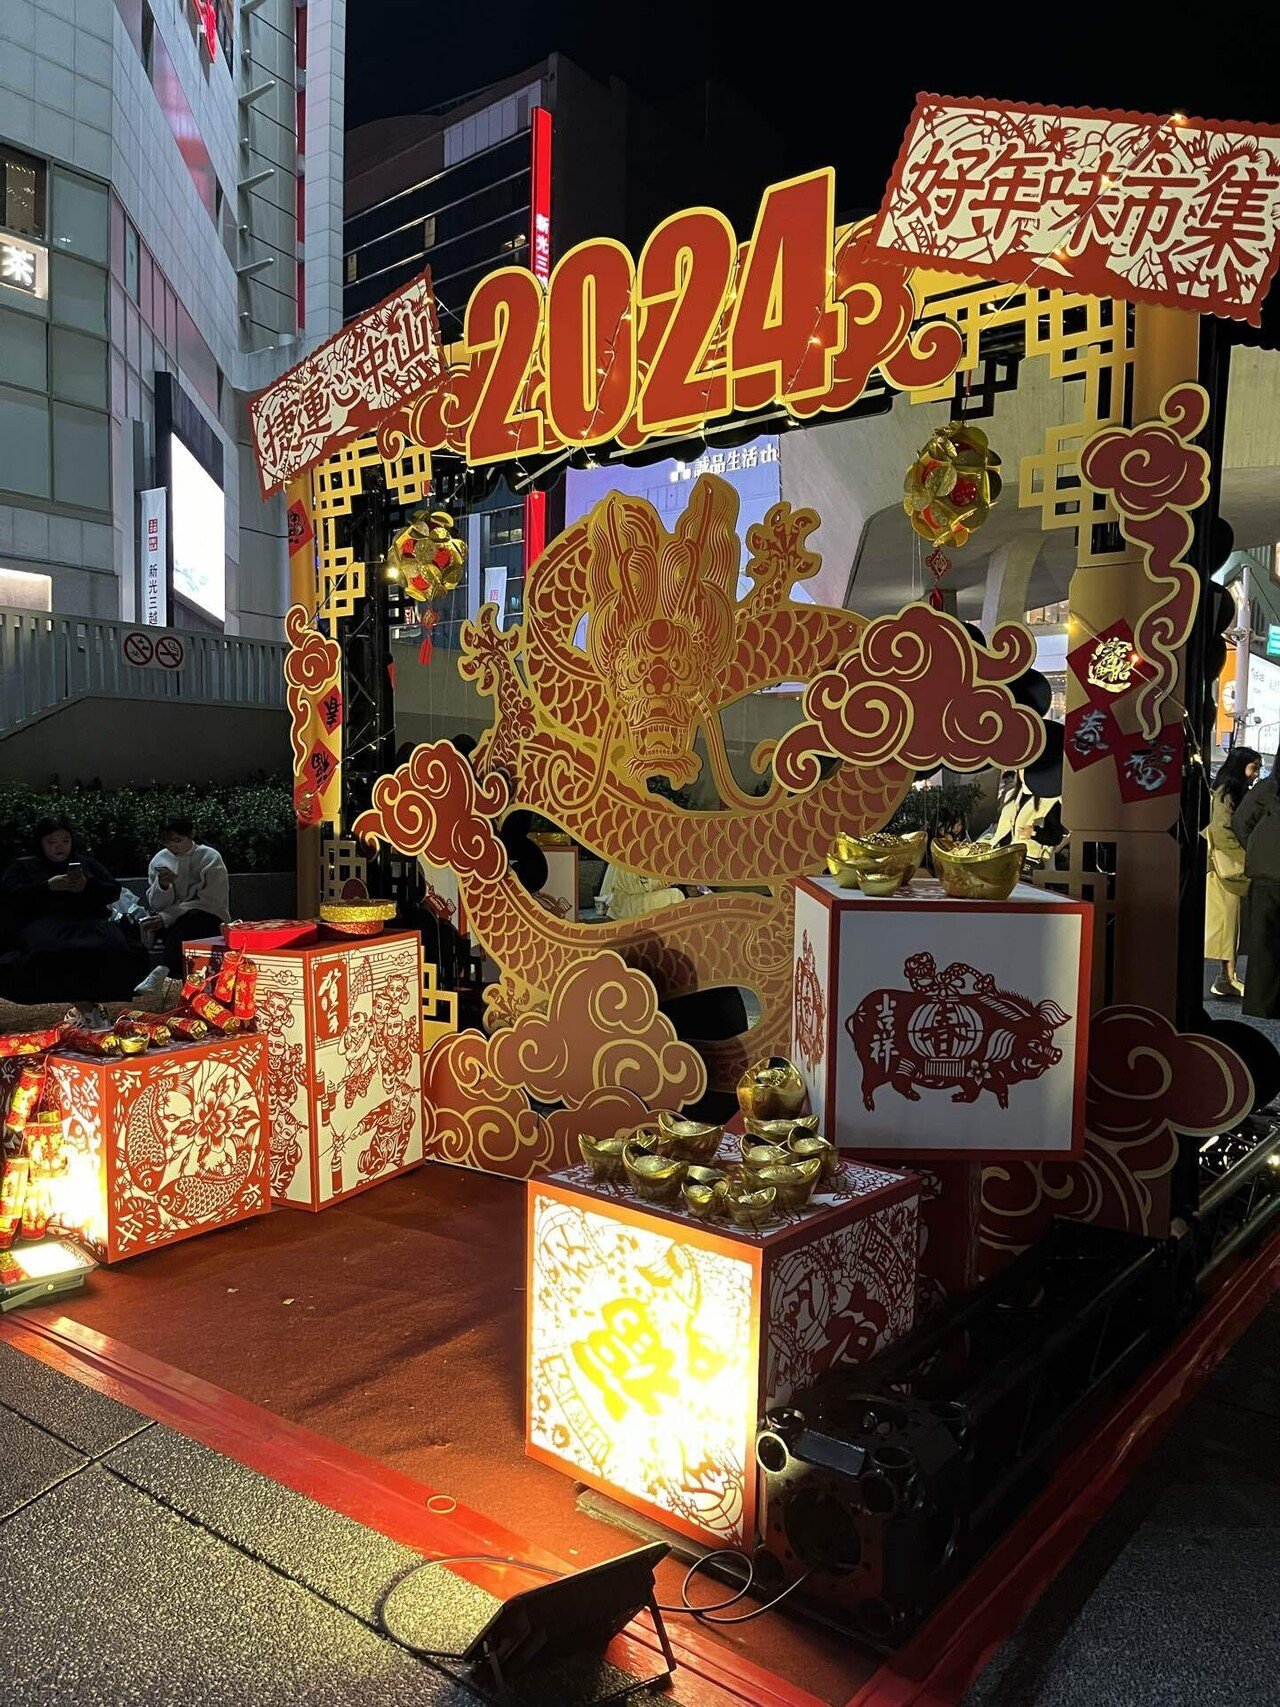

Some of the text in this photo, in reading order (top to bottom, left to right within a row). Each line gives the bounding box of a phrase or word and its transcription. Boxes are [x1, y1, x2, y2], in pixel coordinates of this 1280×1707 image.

[898, 138, 1280, 270] 好年味市集
[464, 165, 849, 467] 2024
[263, 309, 431, 467] 捷運心中山
[693, 442, 779, 479] 誠品生活 th
[148, 563, 158, 625] 新光三越
[870, 993, 900, 1074] 吉祥
